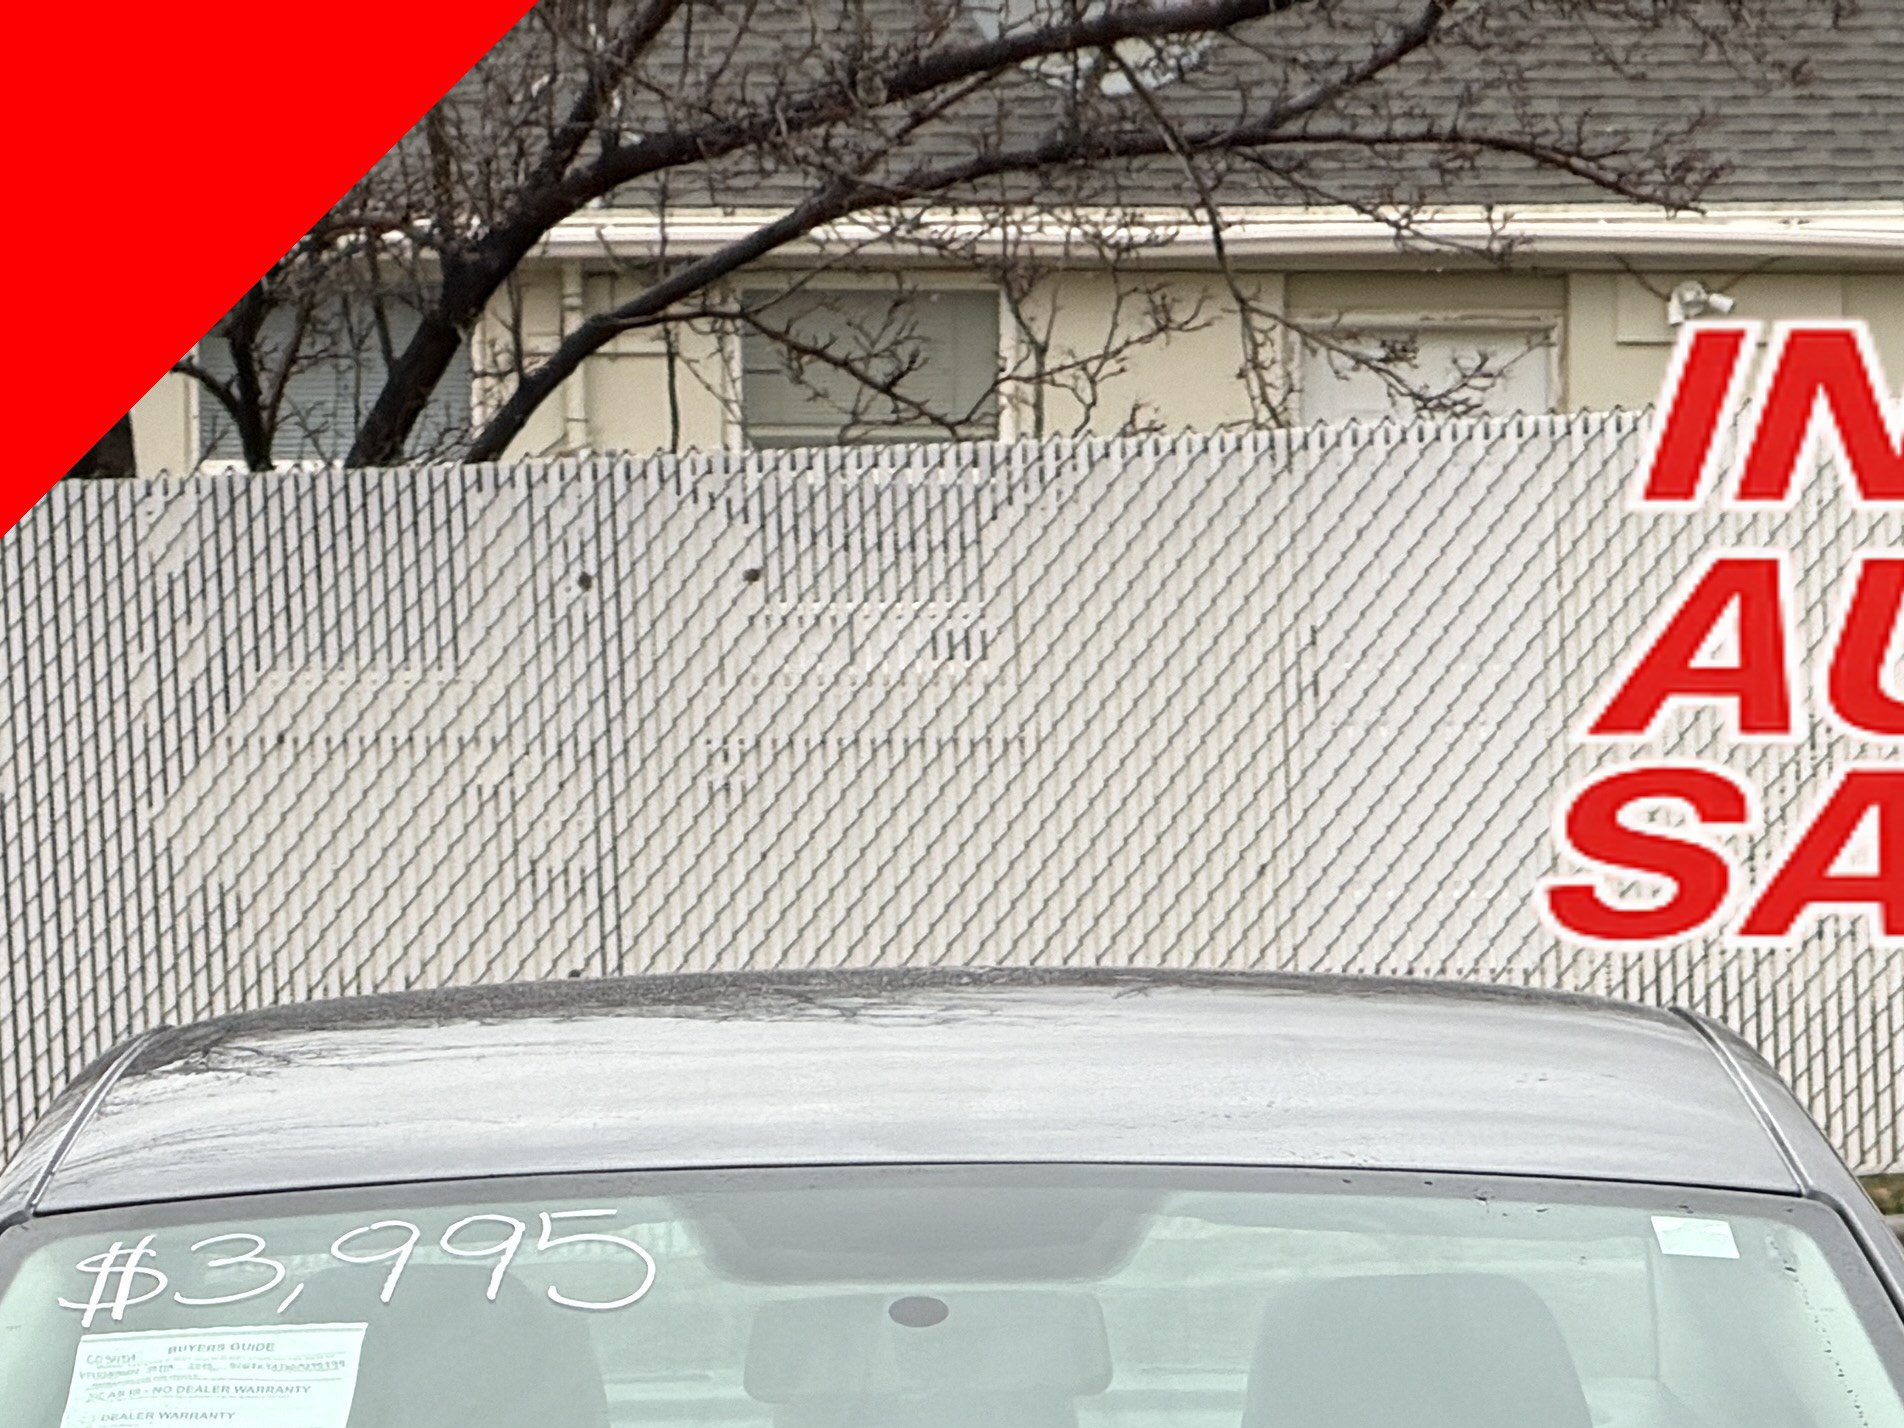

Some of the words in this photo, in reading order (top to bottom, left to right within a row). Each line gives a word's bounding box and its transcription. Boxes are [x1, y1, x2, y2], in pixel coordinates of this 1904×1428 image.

[56, 1208, 657, 1332] $3,995
[230, 1342, 276, 1353] GUIDE
[176, 1384, 230, 1395] DEALER
[234, 1384, 312, 1395] WARRANTY
[100, 1411, 155, 1422] DEALER
[159, 1410, 236, 1421] WARRANTY
